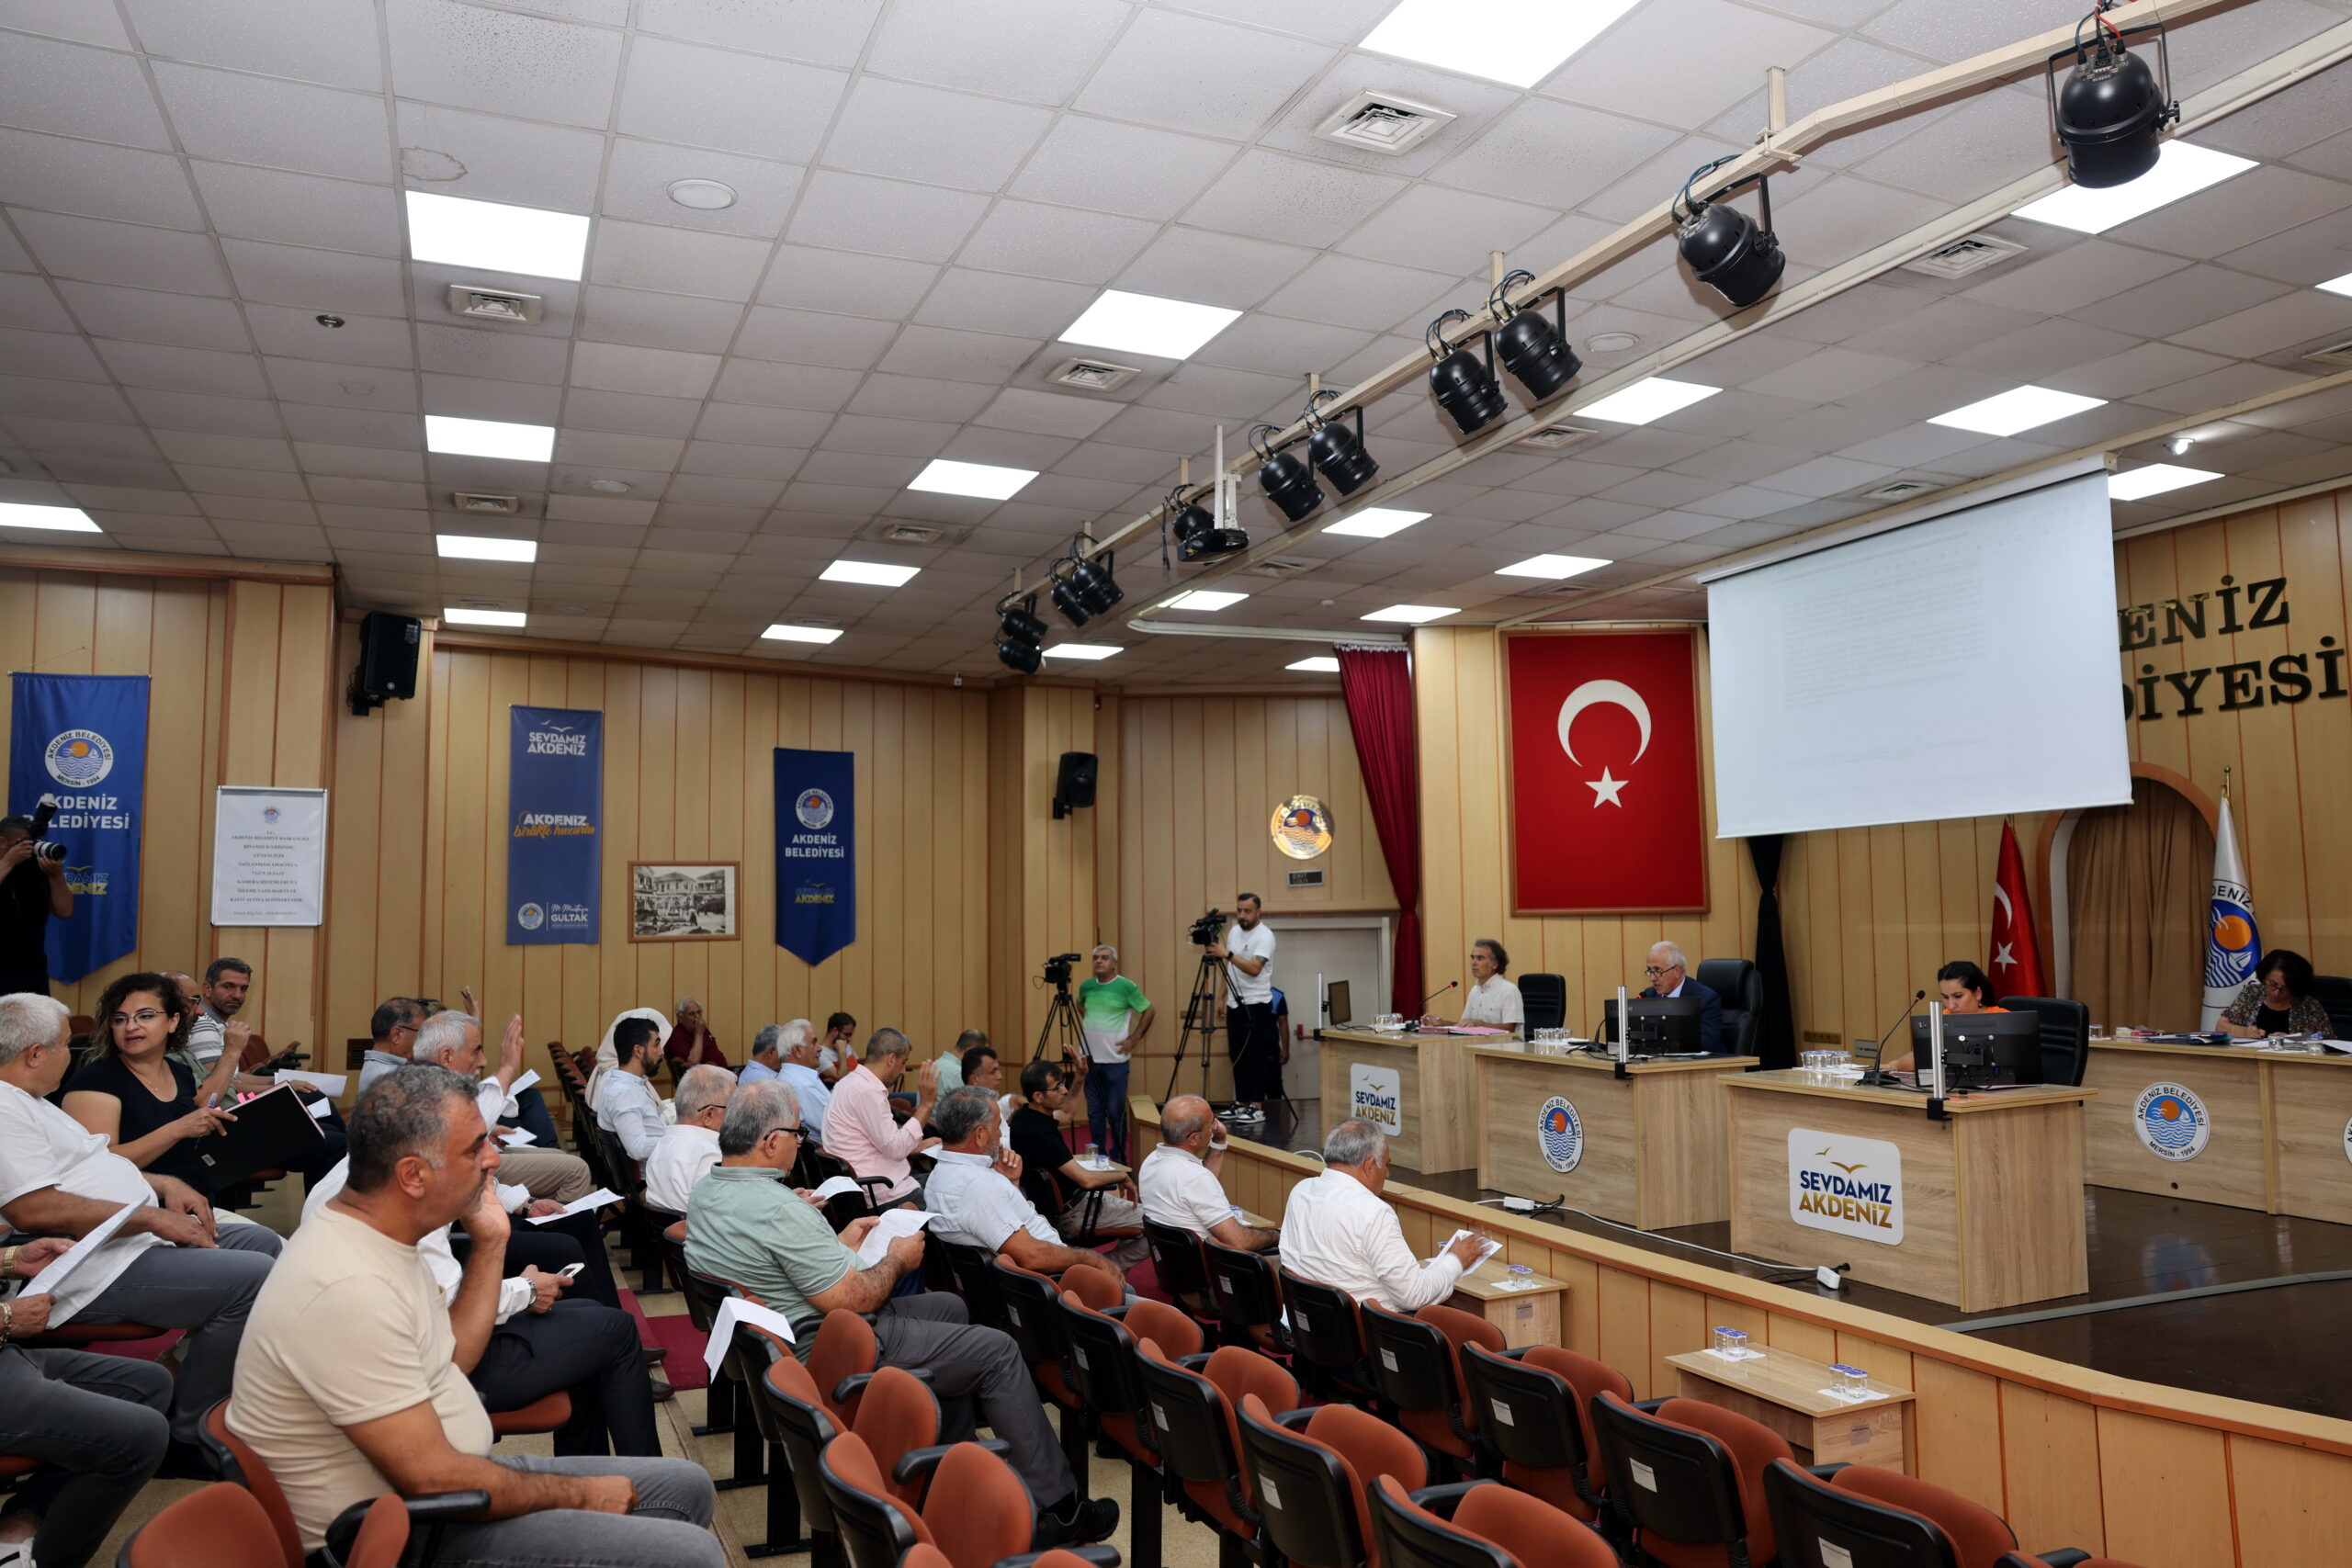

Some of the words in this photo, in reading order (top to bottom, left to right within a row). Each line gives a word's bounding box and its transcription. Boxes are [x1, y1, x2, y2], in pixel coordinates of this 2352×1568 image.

[2117, 574, 2290, 653] ENİZ
[528, 732, 587, 745] SEVDAMIZ
[792, 832, 837, 845] AKDENİZ
[785, 846, 844, 858] BELEDİYESİ
[1355, 1090, 1396, 1111] SEVDAMIZ
[2138, 1088, 2162, 1120] AKDENİZ
[2164, 1087, 2207, 1126] BELEDİYESİ
[2180, 1145, 2196, 1156] 1994
[1800, 1170, 1893, 1205] SEVDAMIZ
